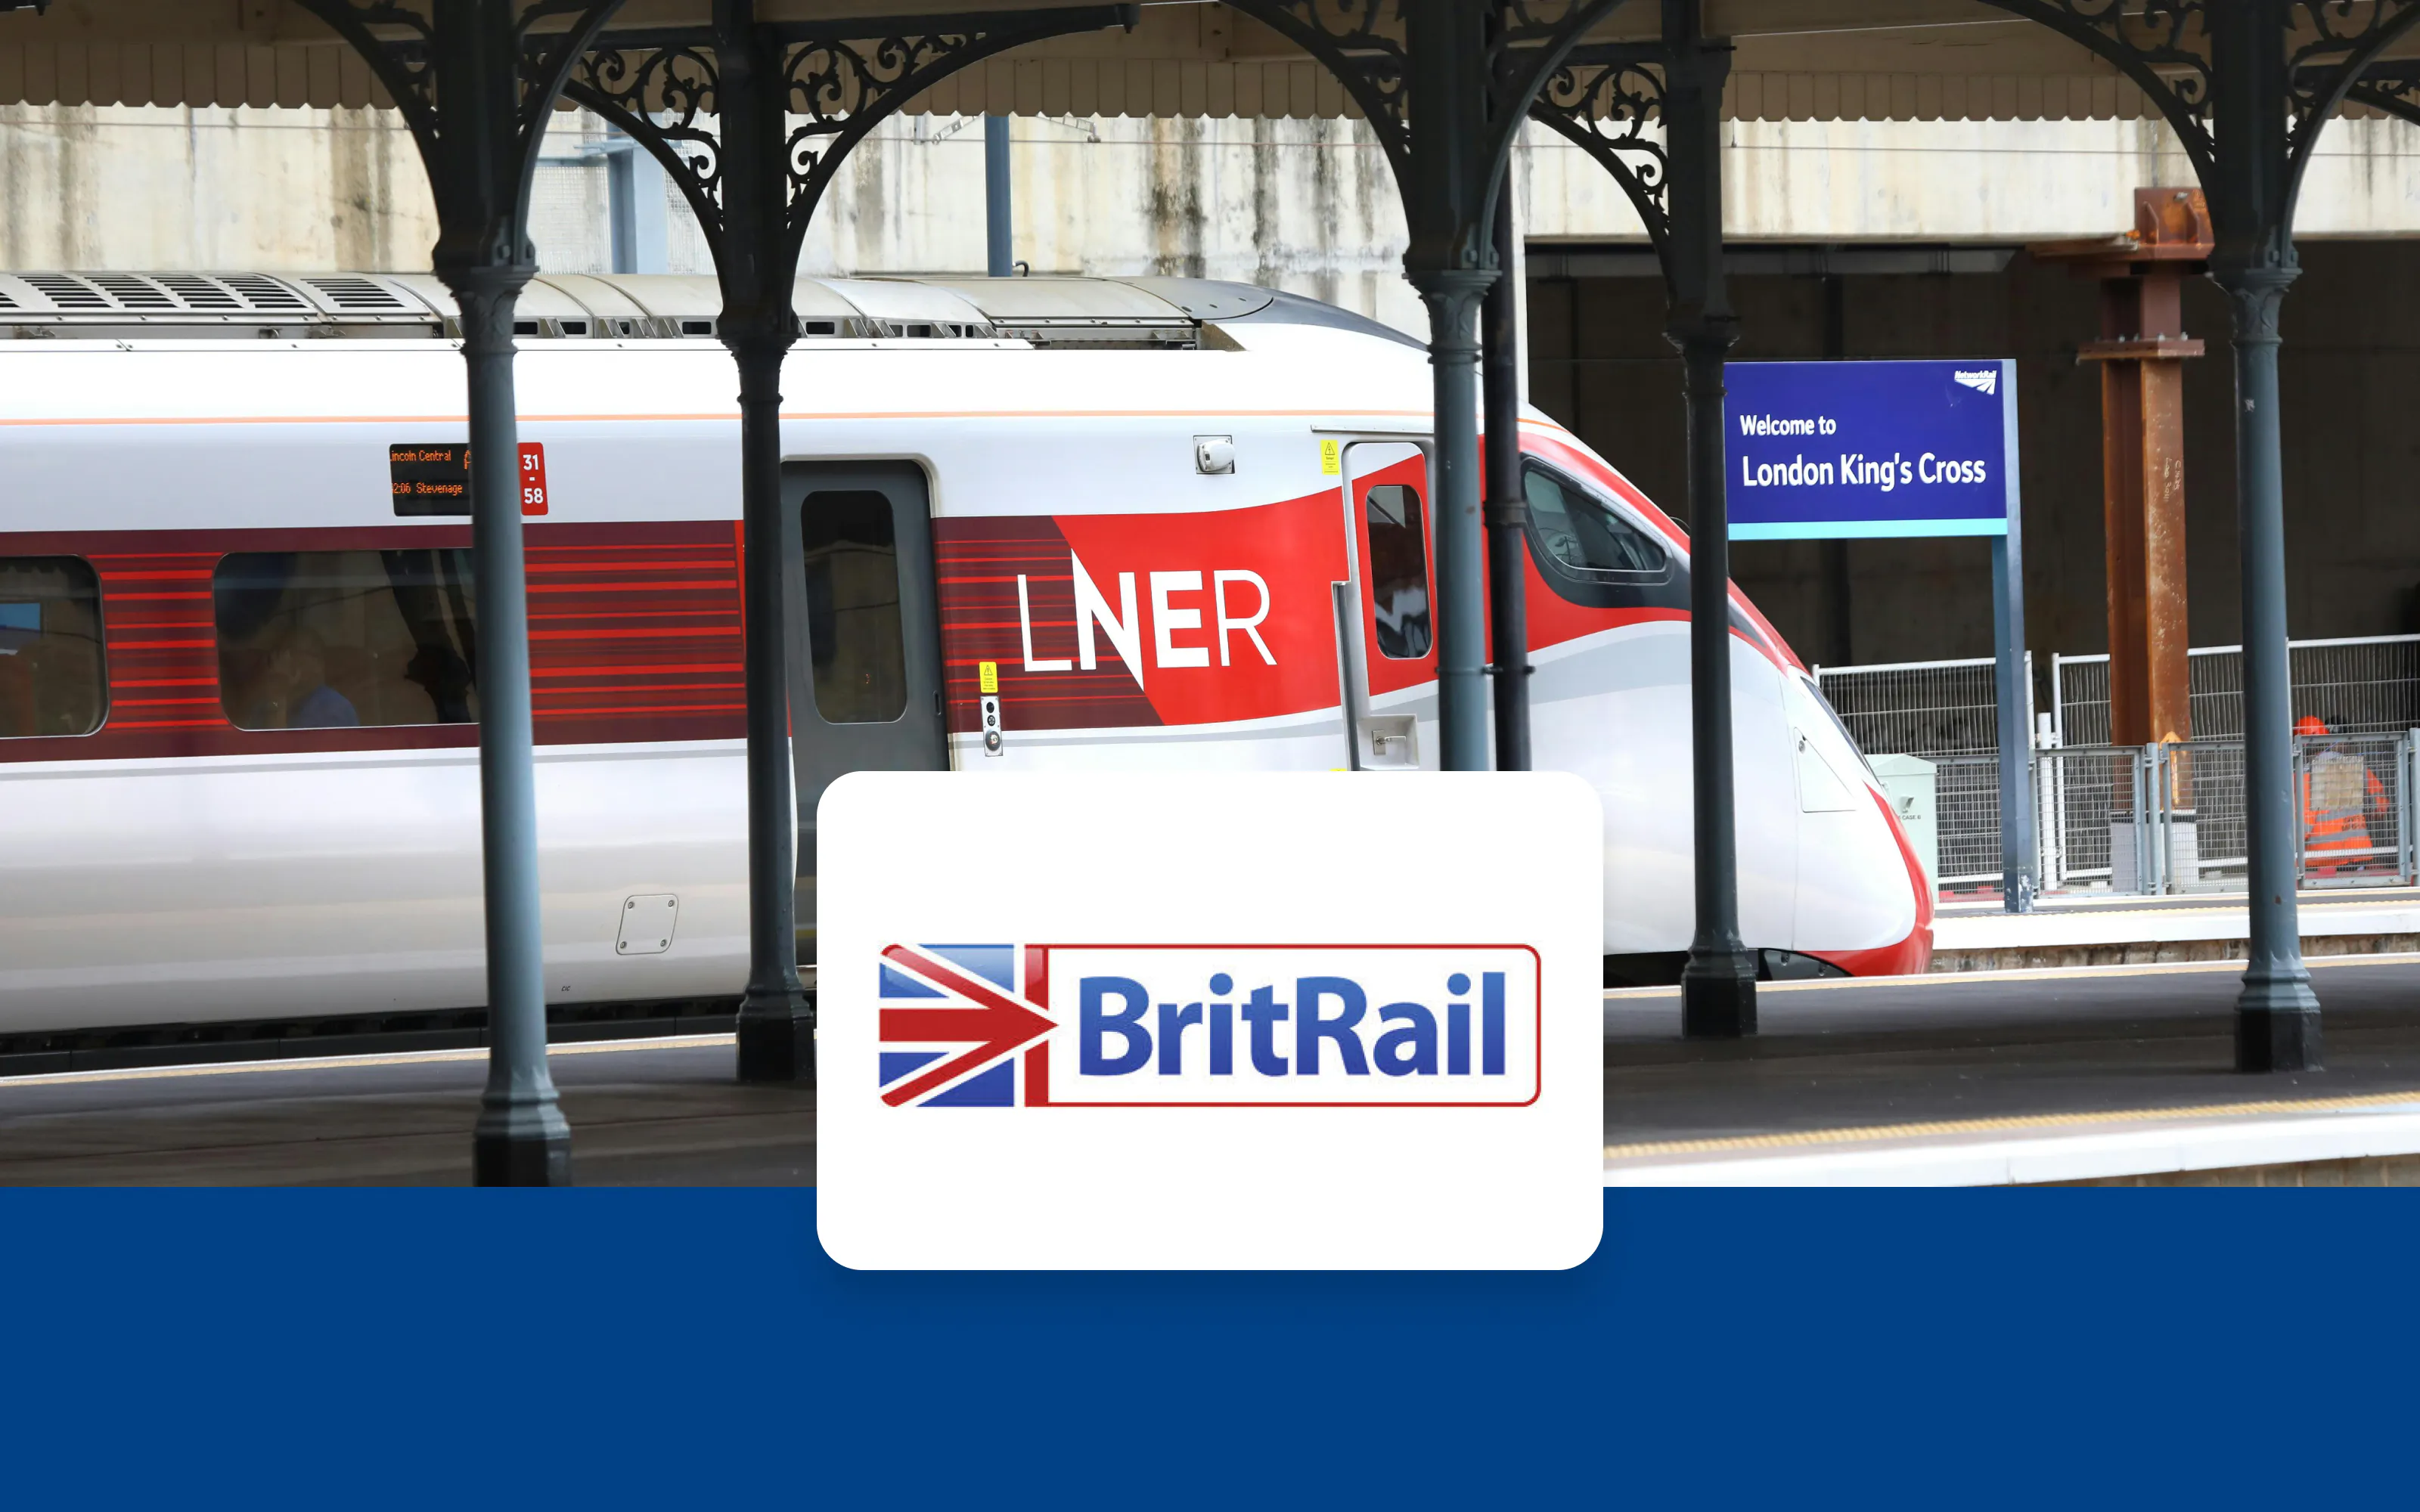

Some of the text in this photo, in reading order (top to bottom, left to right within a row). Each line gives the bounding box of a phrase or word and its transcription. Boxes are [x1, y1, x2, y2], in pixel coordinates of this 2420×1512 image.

[1739, 414, 1837, 436] Welcome to
[389, 450, 417, 461] incoln
[419, 450, 451, 461] Central
[523, 454, 539, 470] 31
[1742, 452, 1987, 492] London King's Cross
[416, 482, 463, 496] Stevenage
[524, 488, 544, 504] 58
[1017, 548, 1278, 692] LNER
